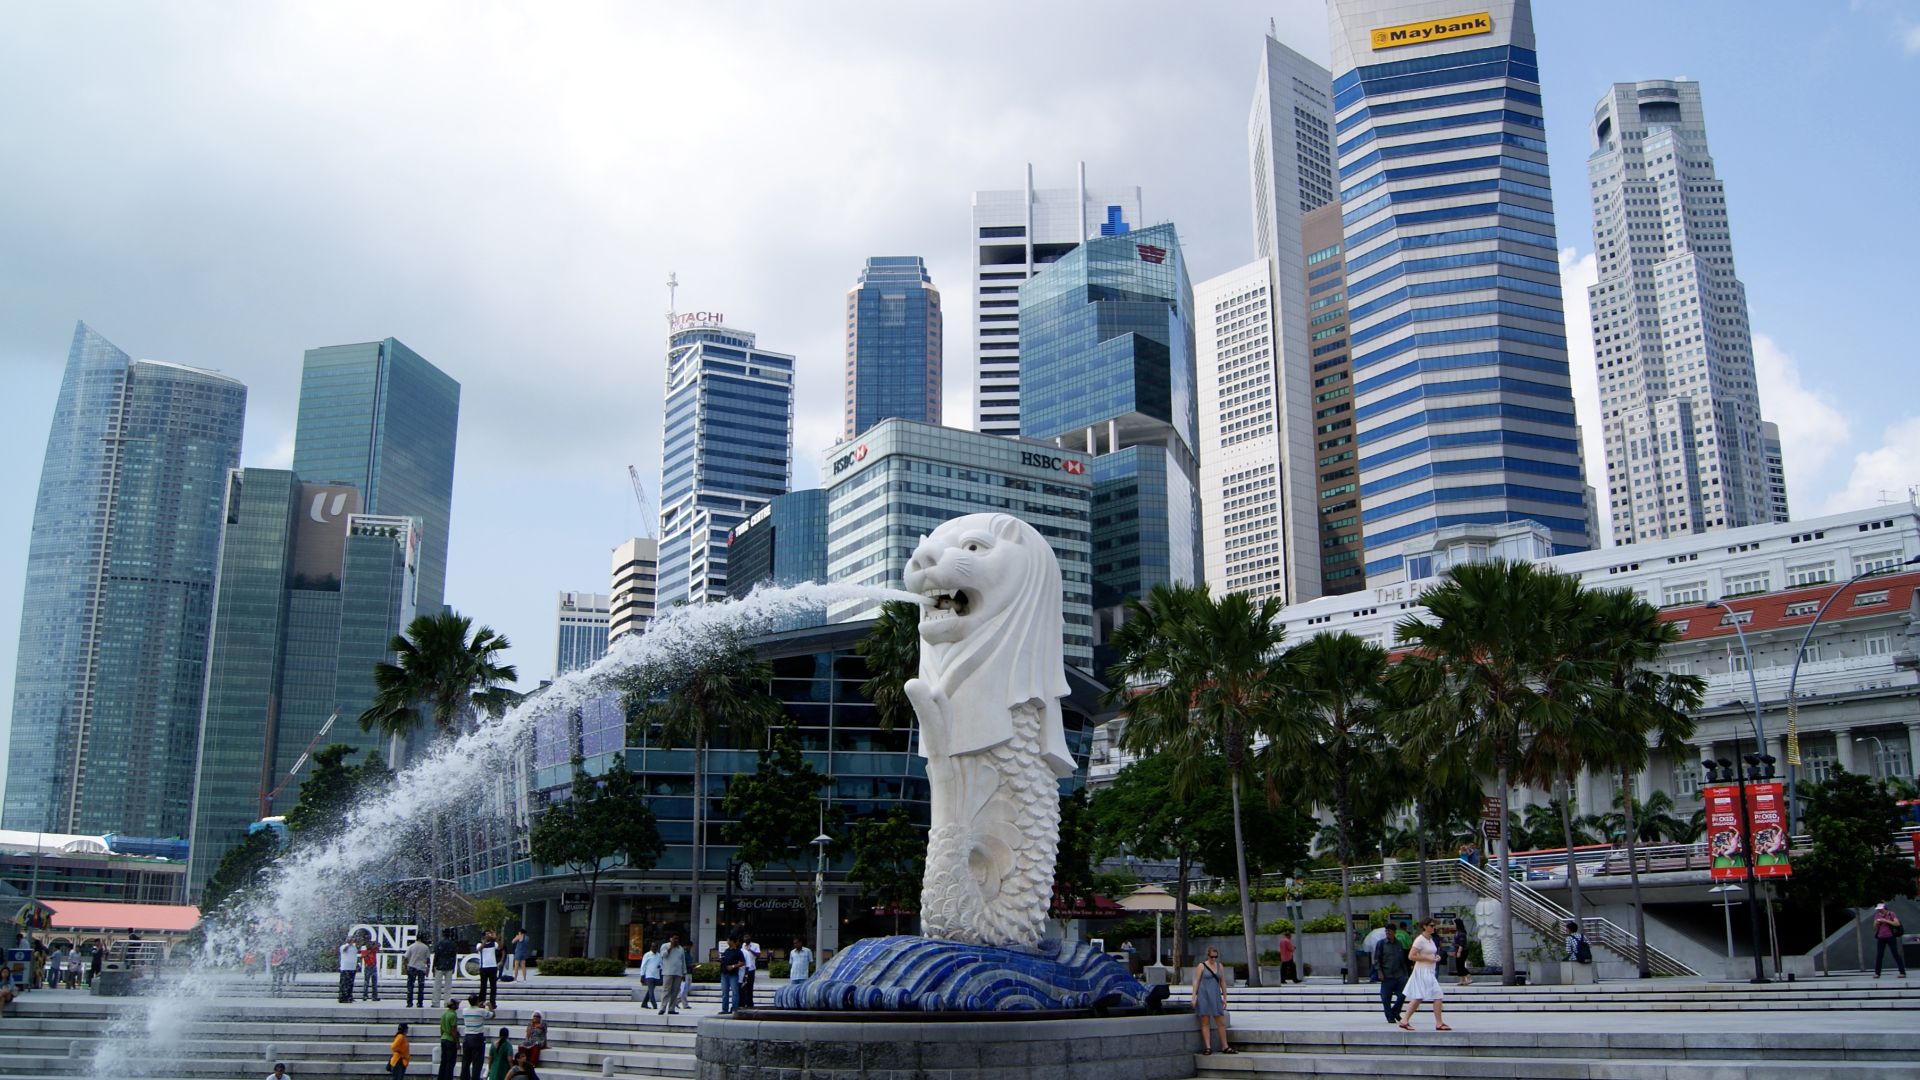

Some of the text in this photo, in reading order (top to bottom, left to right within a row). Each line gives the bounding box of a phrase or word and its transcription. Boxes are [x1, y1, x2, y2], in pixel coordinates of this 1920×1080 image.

[1390, 19, 1486, 40] Maybank
[833, 451, 855, 475] HSBC
[1021, 451, 1061, 471] HSBC
[1374, 587, 1403, 602] THE
[753, 898, 788, 909] Coffee
[348, 924, 418, 950] ONE
